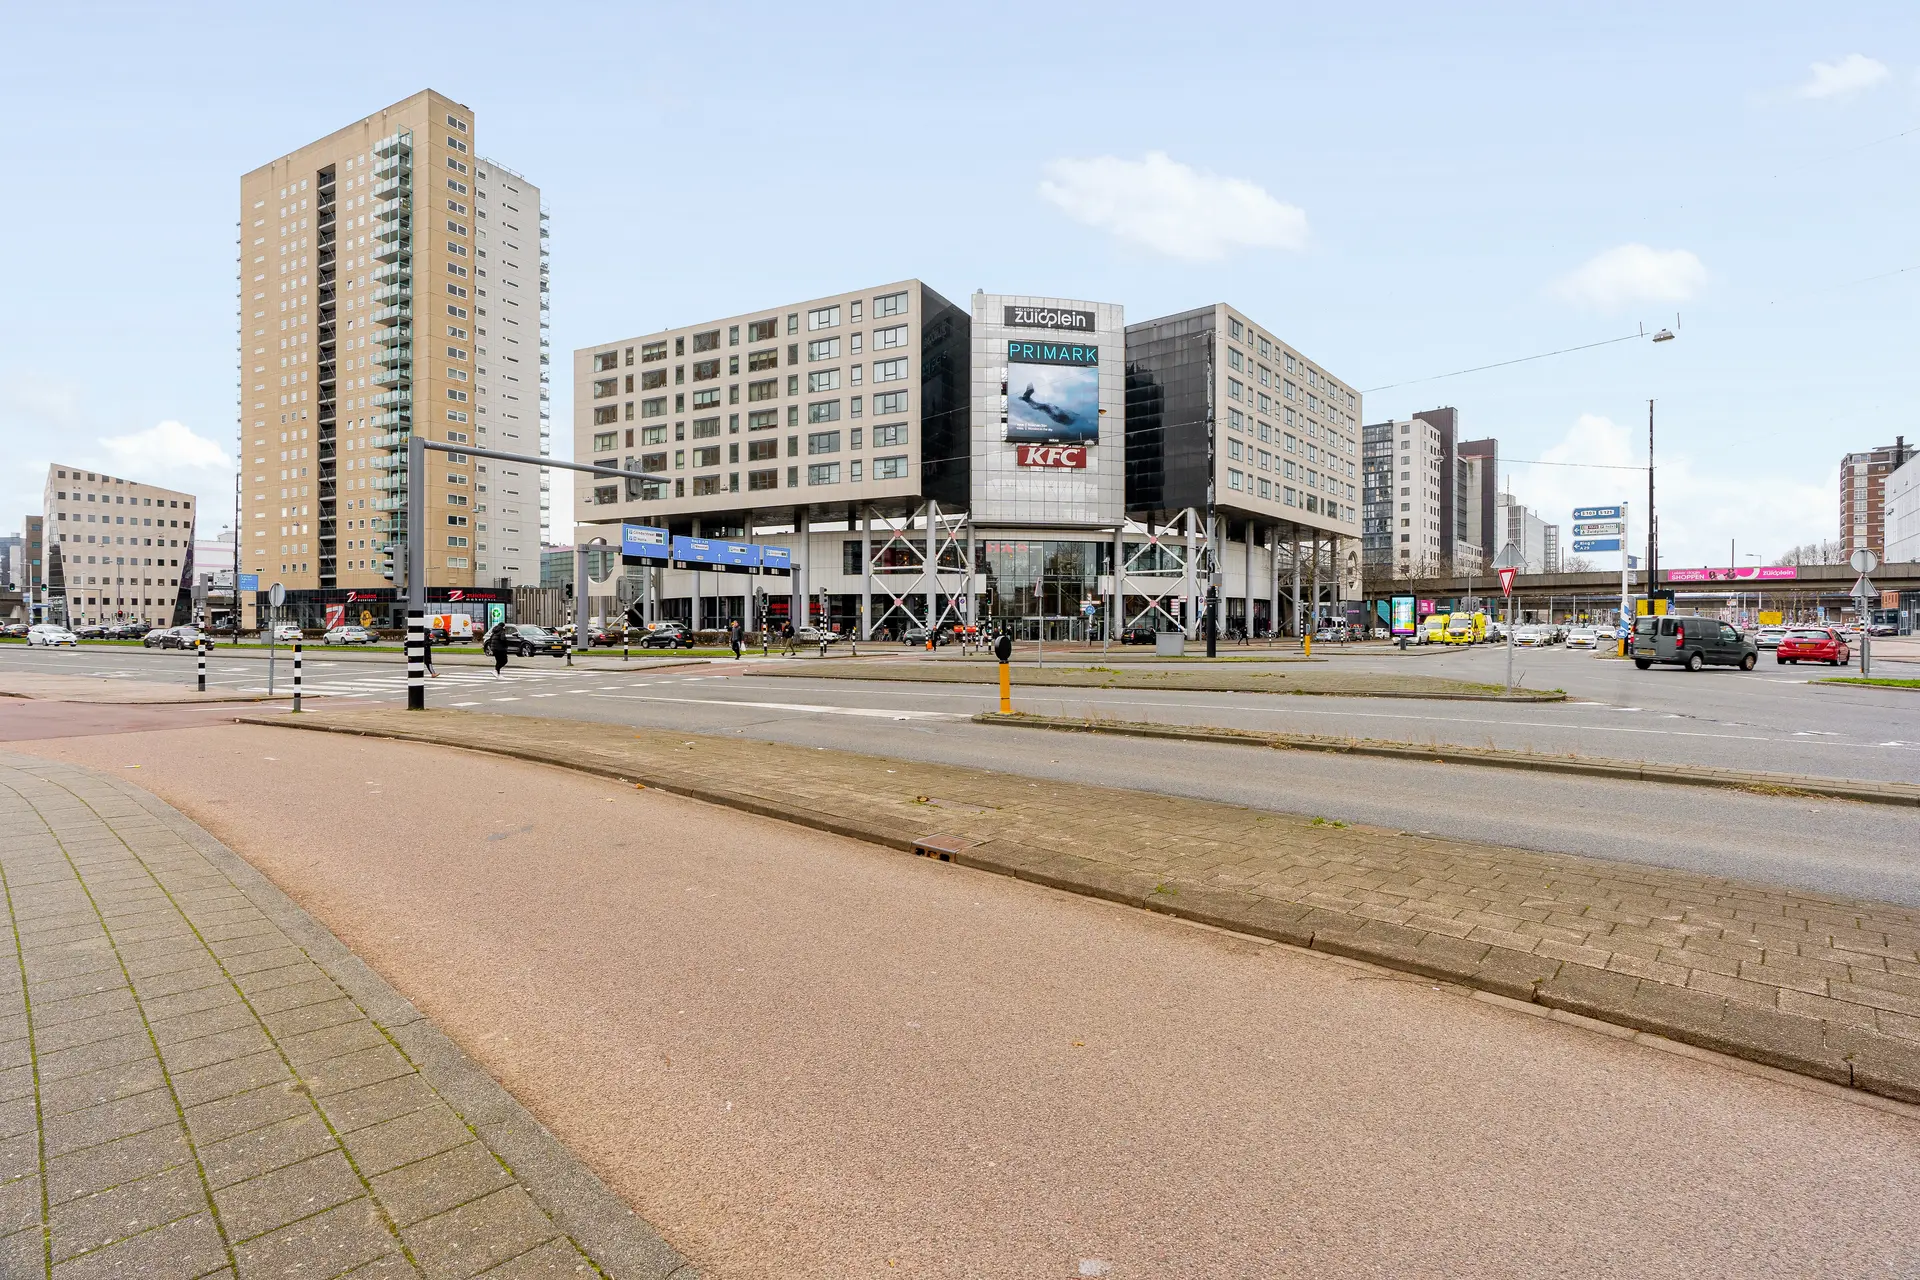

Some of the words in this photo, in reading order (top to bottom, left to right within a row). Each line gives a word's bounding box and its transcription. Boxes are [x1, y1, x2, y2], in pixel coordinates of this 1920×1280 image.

[1015, 309, 1086, 327] zuidplein
[1009, 343, 1097, 362] PRIMARK
[1024, 447, 1079, 466] KFC
